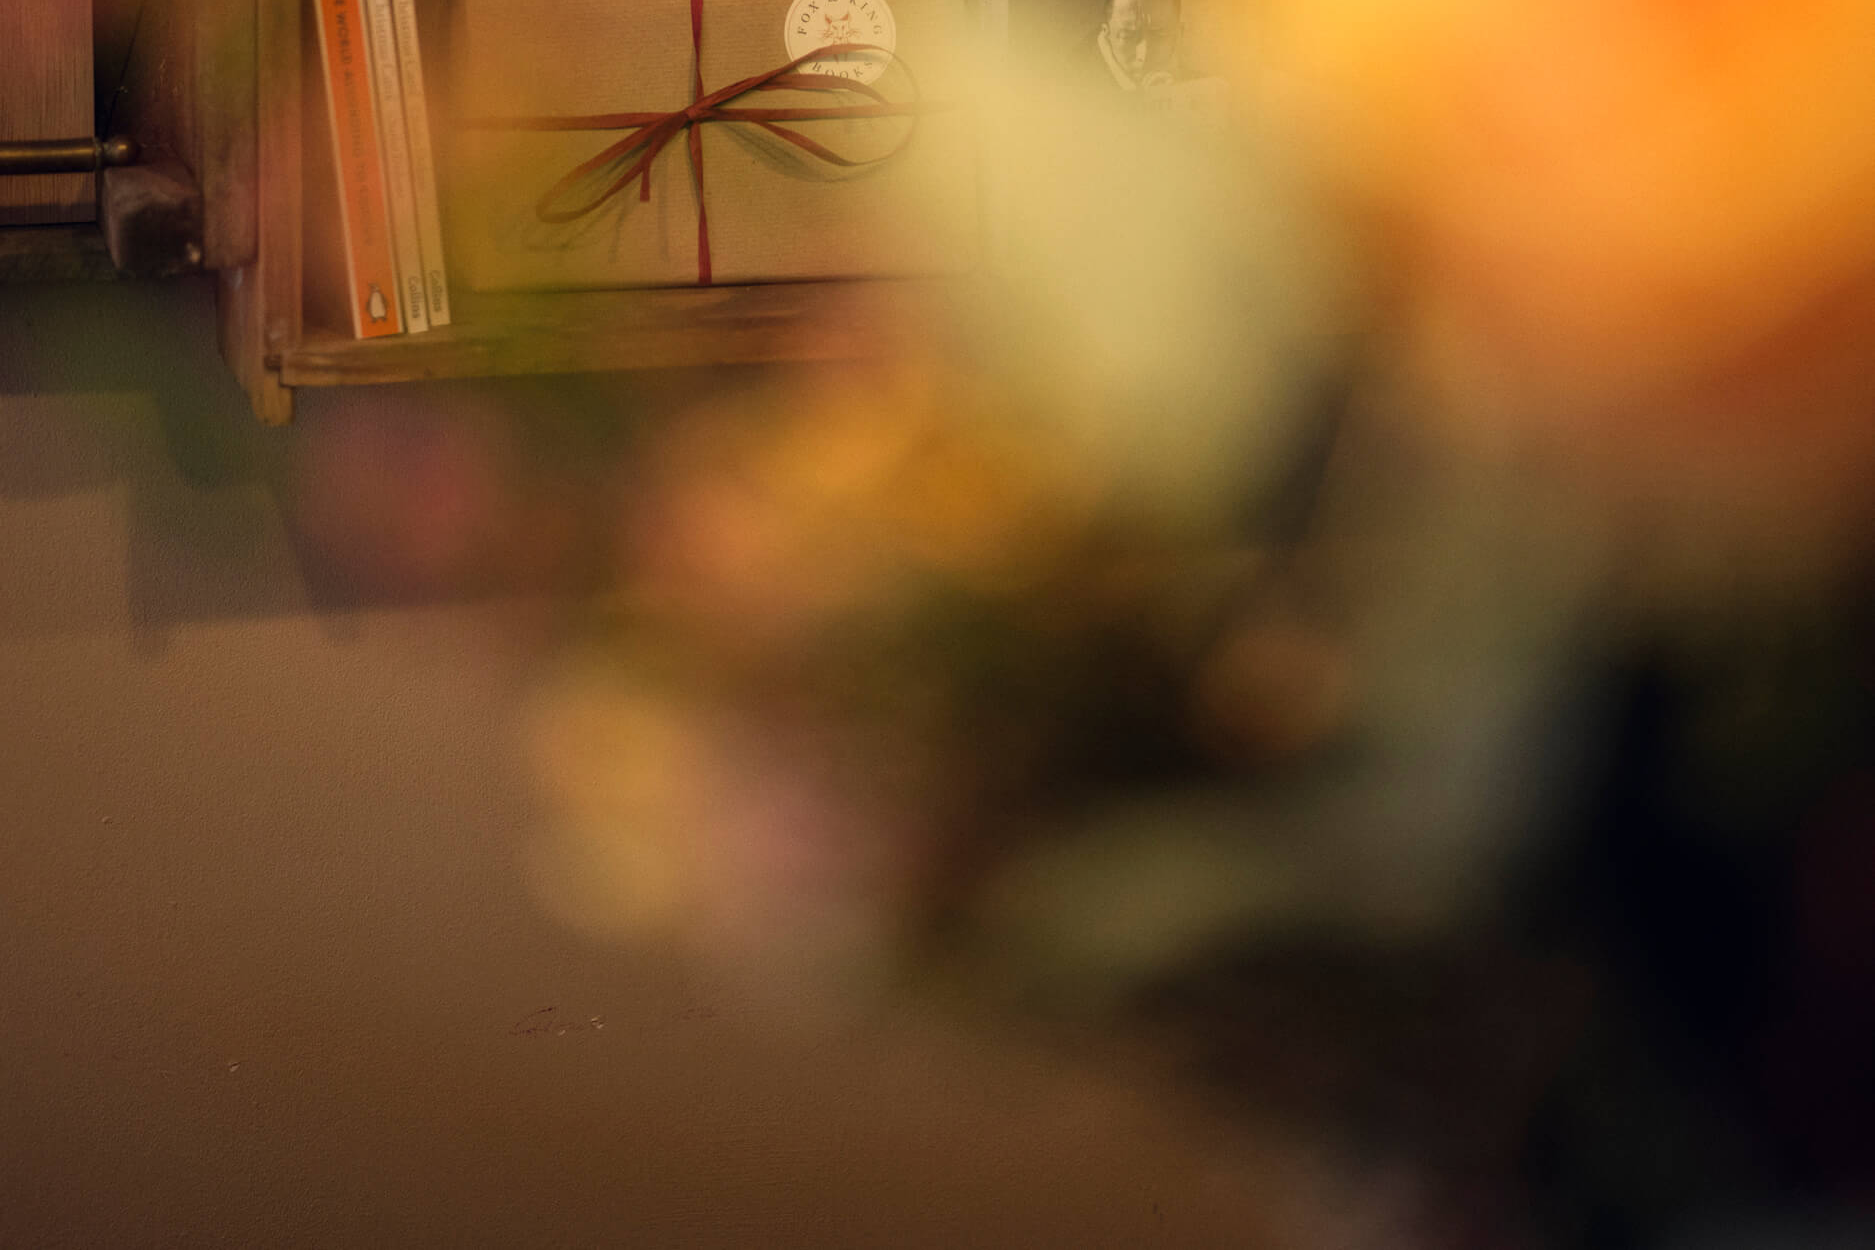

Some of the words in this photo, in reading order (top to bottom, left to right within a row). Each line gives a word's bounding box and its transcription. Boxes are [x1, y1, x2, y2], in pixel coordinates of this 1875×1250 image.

[797, 0, 820, 36] FOX
[406, 275, 424, 319] Collins
[430, 268, 445, 312] Collins
